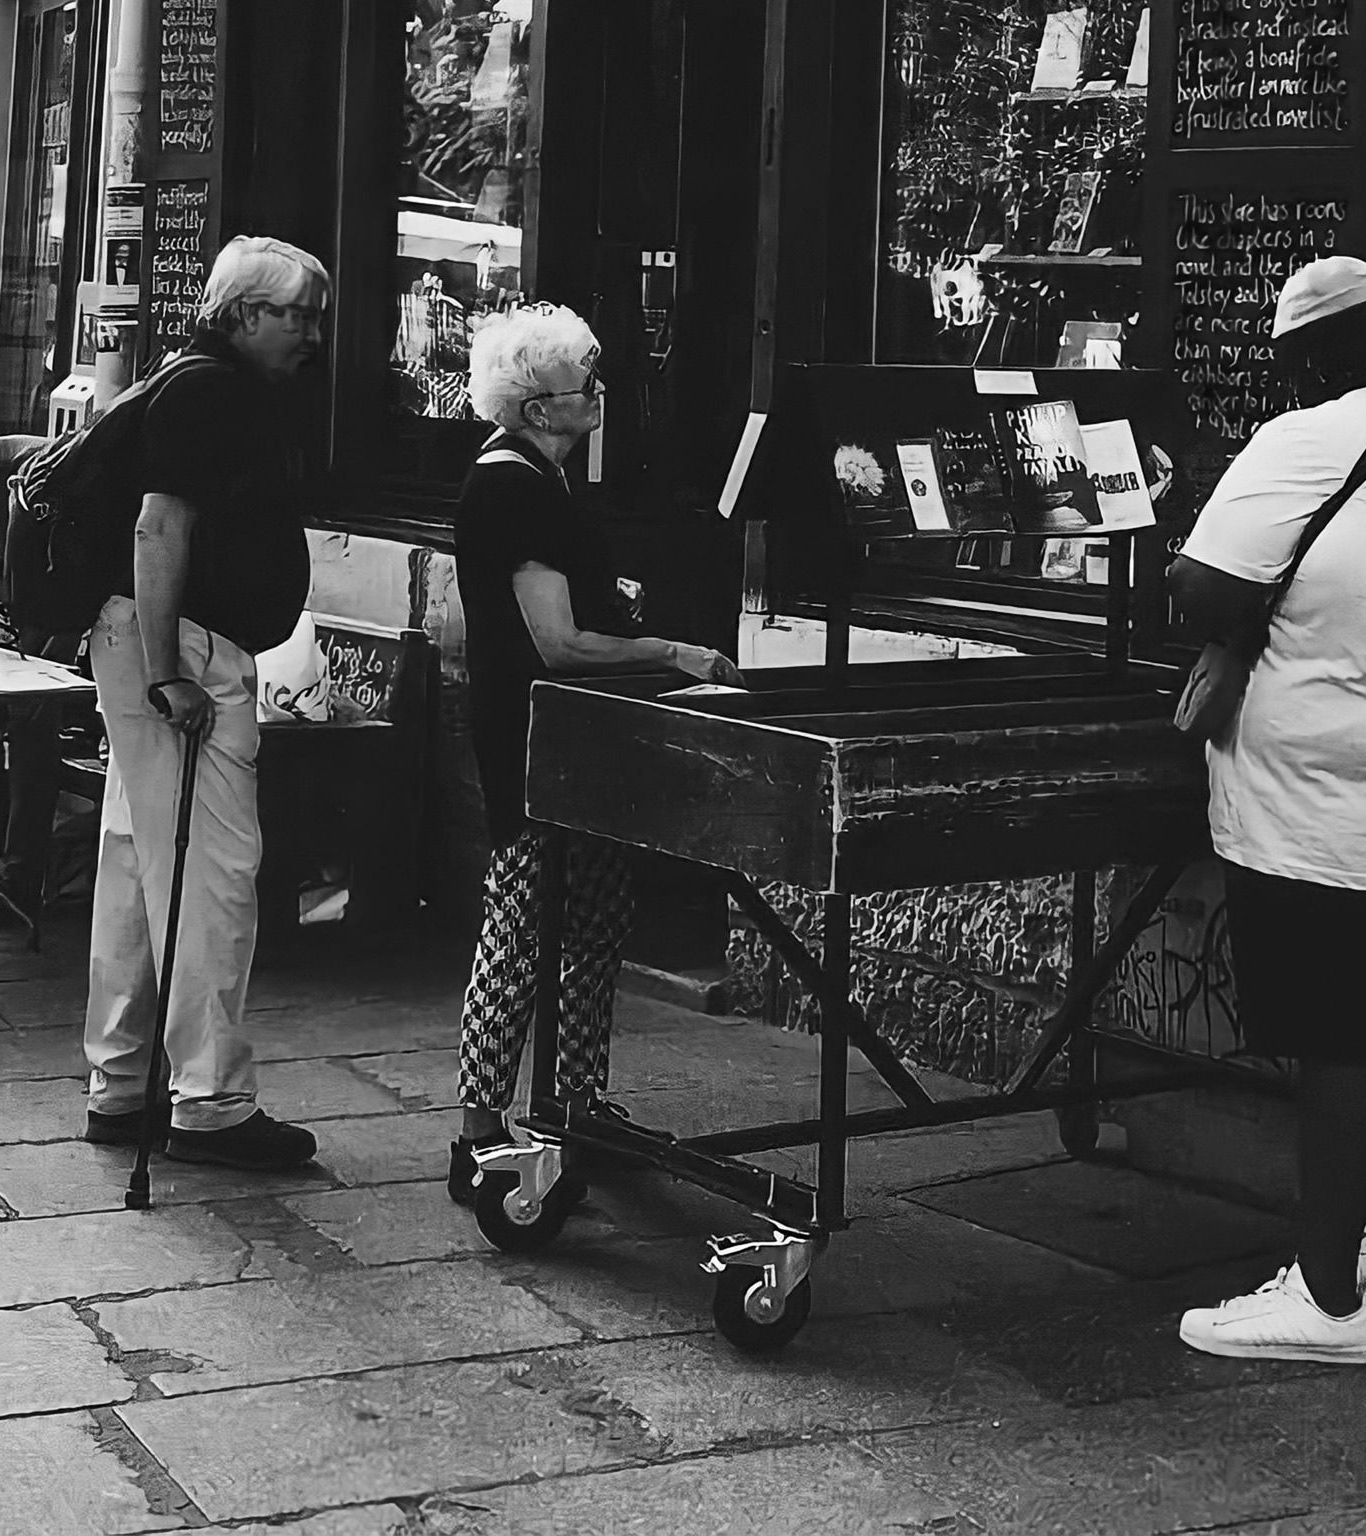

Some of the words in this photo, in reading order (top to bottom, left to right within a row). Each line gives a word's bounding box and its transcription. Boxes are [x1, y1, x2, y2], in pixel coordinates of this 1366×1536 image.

[1177, 47, 1194, 80] of
[1174, 113, 1183, 132] a
[1186, 98, 1271, 139] frustrated
[1179, 194, 1216, 224] This
[1261, 195, 1288, 222] has
[1300, 225, 1314, 247] in
[1324, 229, 1335, 248] a
[1259, 254, 1284, 277] the
[1175, 338, 1210, 360] than
